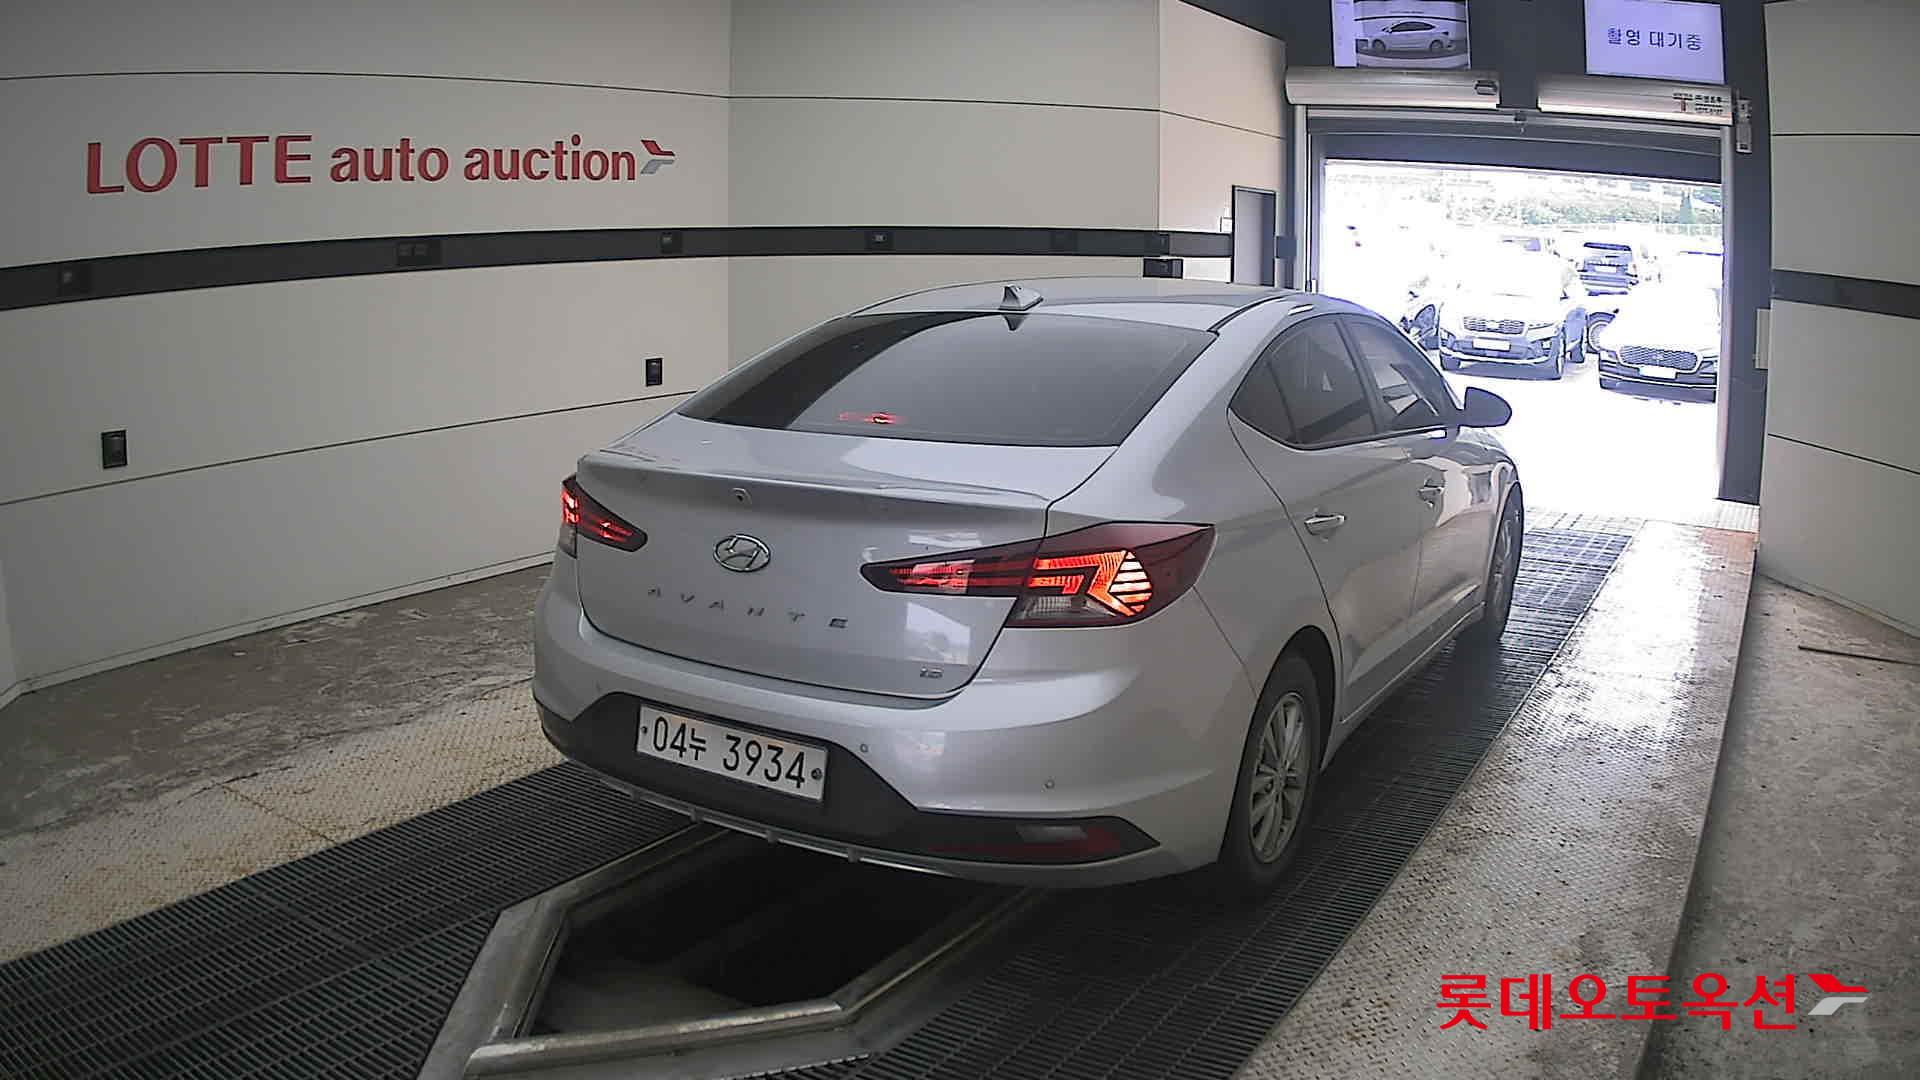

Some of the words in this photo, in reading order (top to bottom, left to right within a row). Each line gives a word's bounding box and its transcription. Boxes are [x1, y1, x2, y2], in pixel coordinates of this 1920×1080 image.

[87, 134, 312, 194] LOTTE
[329, 138, 449, 183] auto
[463, 134, 637, 182] auction
[653, 716, 707, 761] 04누
[722, 734, 806, 789] 3934
